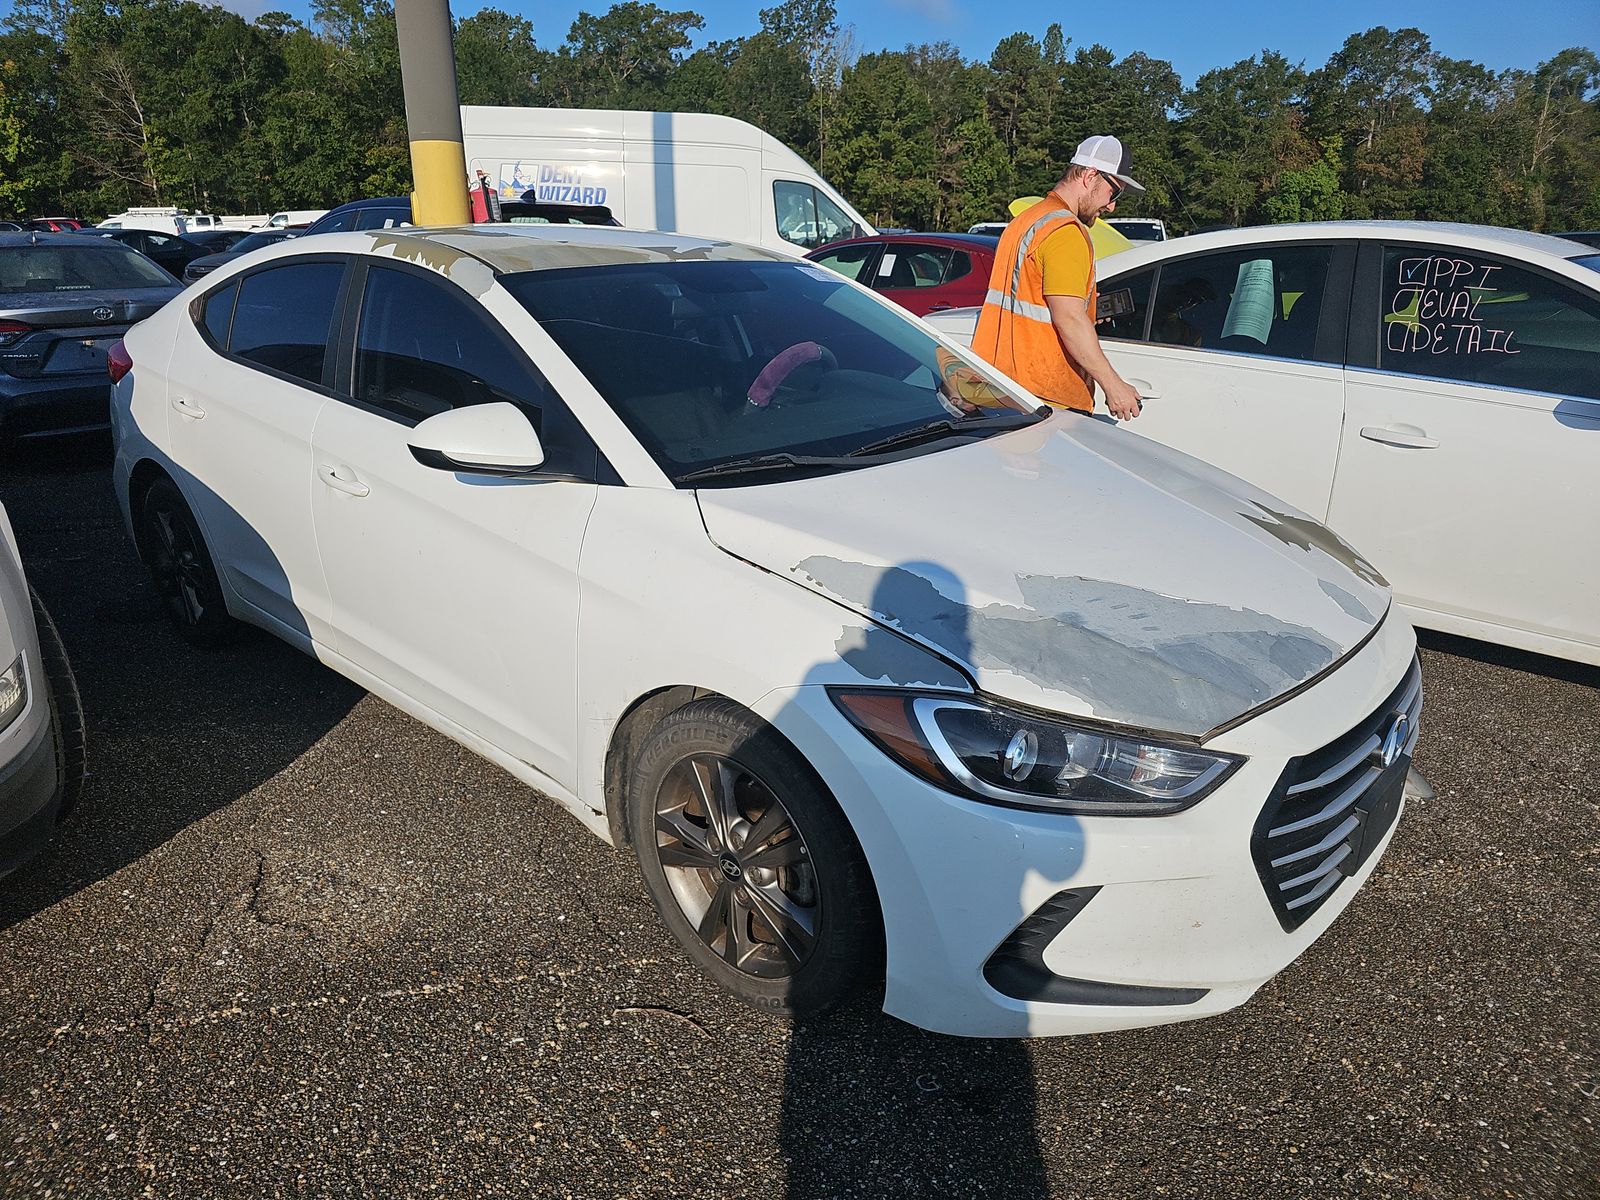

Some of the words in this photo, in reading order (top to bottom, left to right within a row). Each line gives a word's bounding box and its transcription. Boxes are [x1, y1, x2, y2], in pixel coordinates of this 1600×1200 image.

[539, 185, 607, 205] WIZARD
[1420, 289, 1484, 321] EVAL
[1409, 322, 1521, 354] DETAIL
